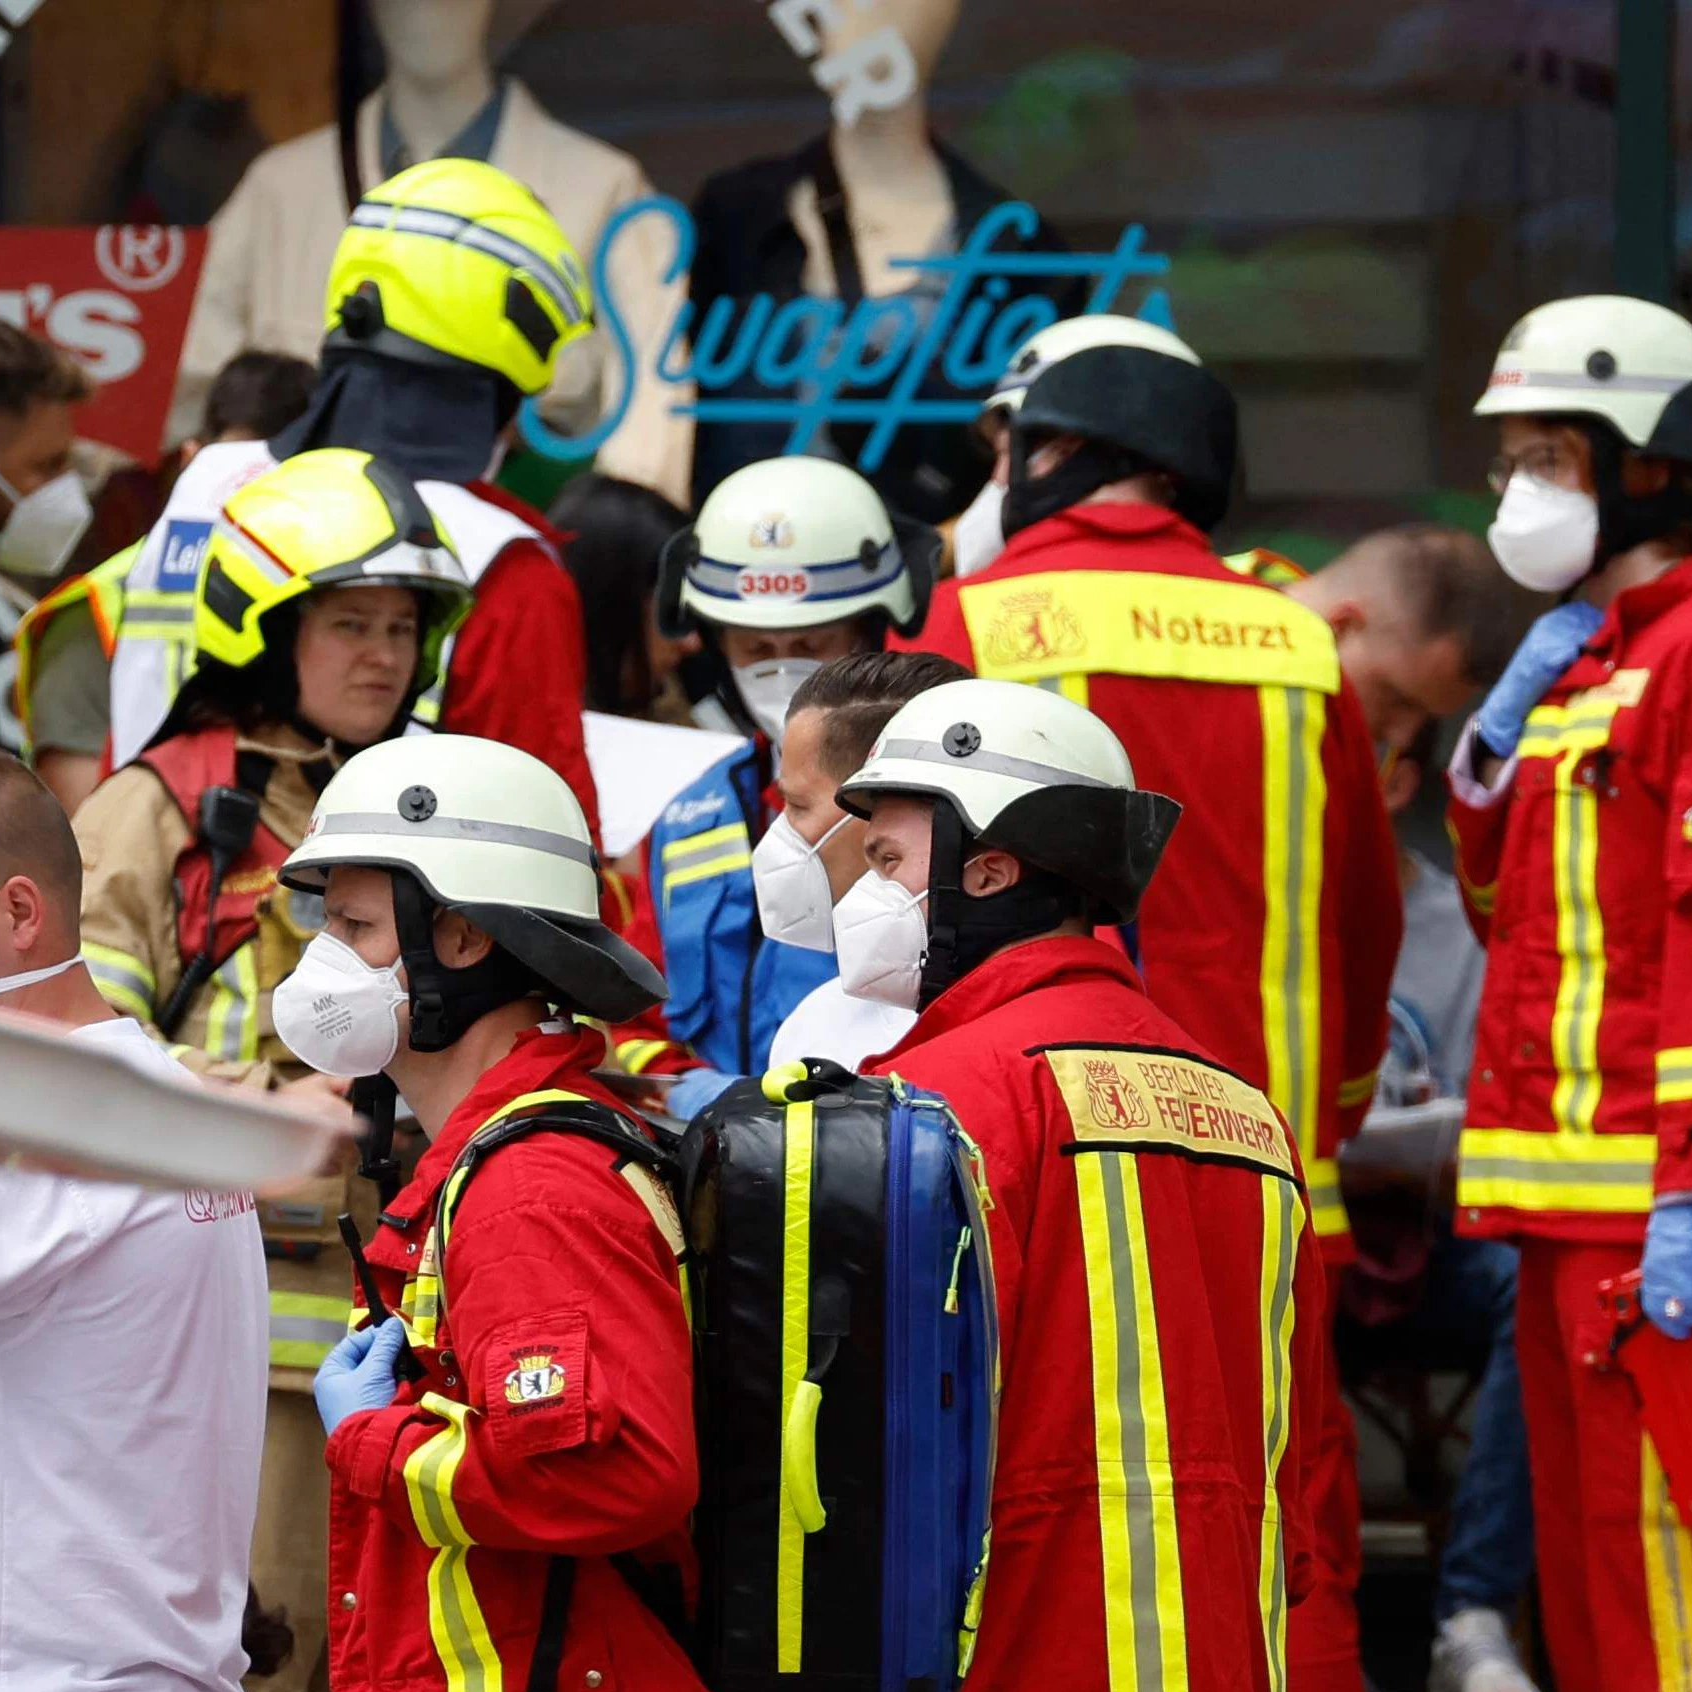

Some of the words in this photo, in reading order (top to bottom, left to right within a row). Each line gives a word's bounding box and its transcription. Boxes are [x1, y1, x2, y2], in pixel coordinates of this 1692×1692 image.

[741, 573, 807, 594] 3305
[1131, 604, 1298, 653] Notarzt
[1137, 1062, 1231, 1105] BERLINER
[1153, 1094, 1281, 1158] FEUERWEHR
